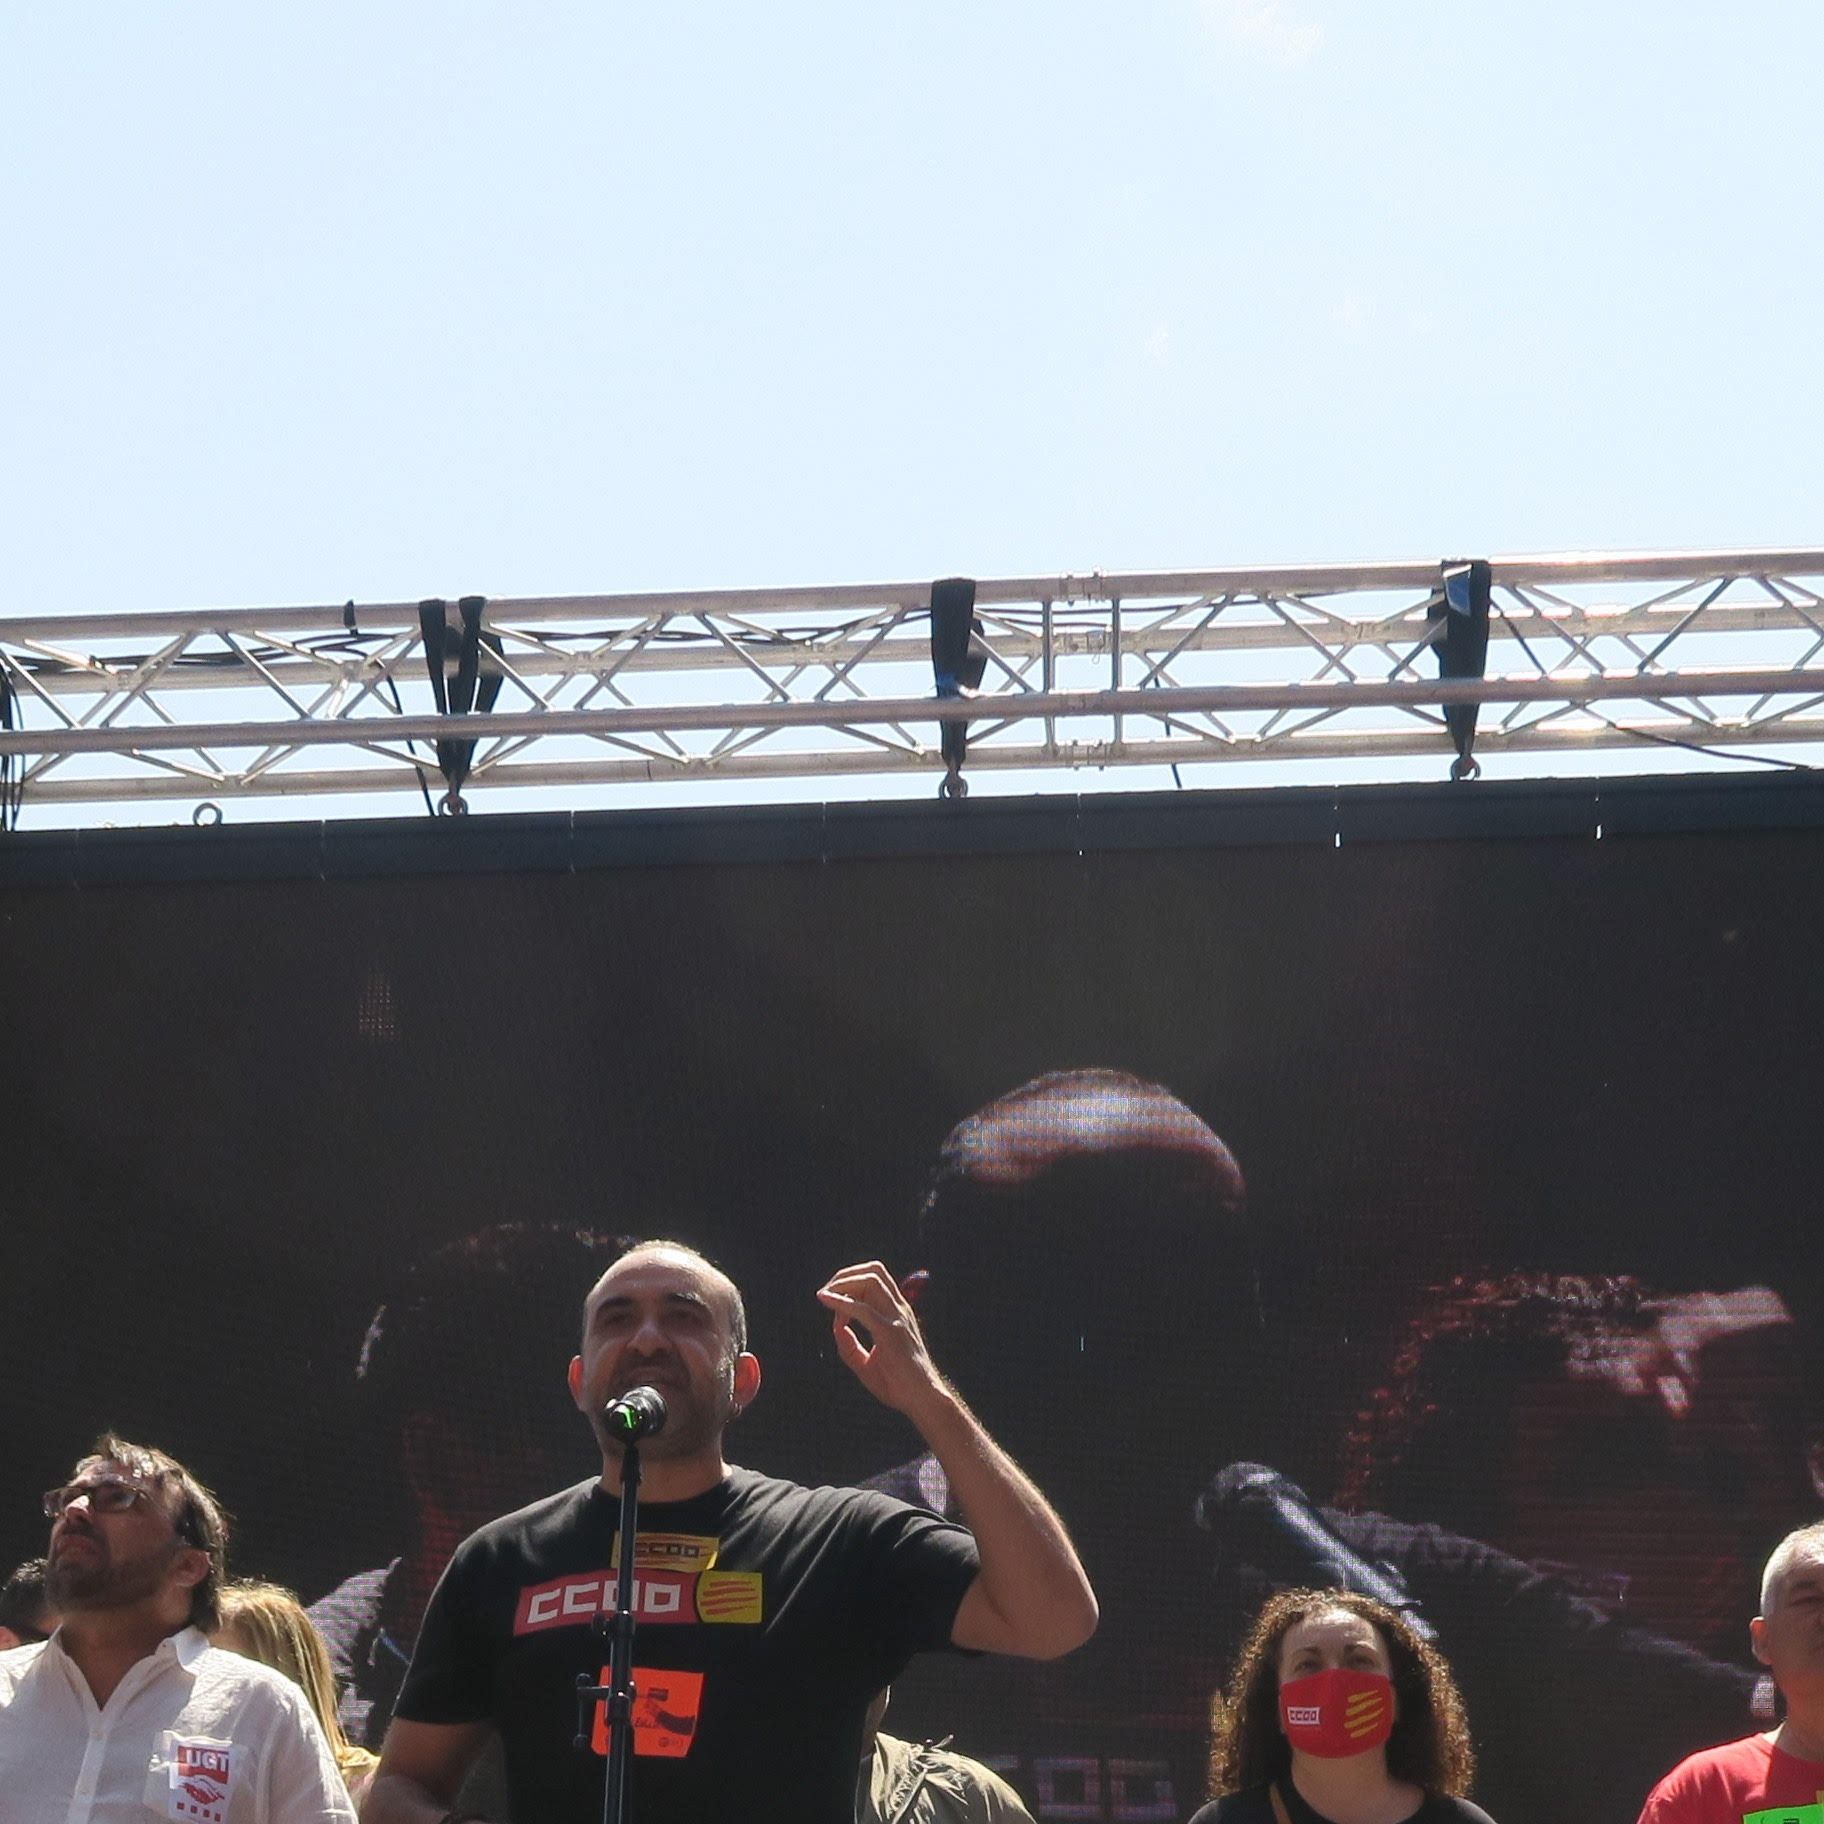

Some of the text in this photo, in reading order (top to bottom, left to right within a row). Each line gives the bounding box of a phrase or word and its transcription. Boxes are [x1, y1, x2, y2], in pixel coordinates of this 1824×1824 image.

[527, 1579, 682, 1624] CCOO
[1289, 1709, 1318, 1722] CCOO
[186, 1748, 229, 1774] UGT
